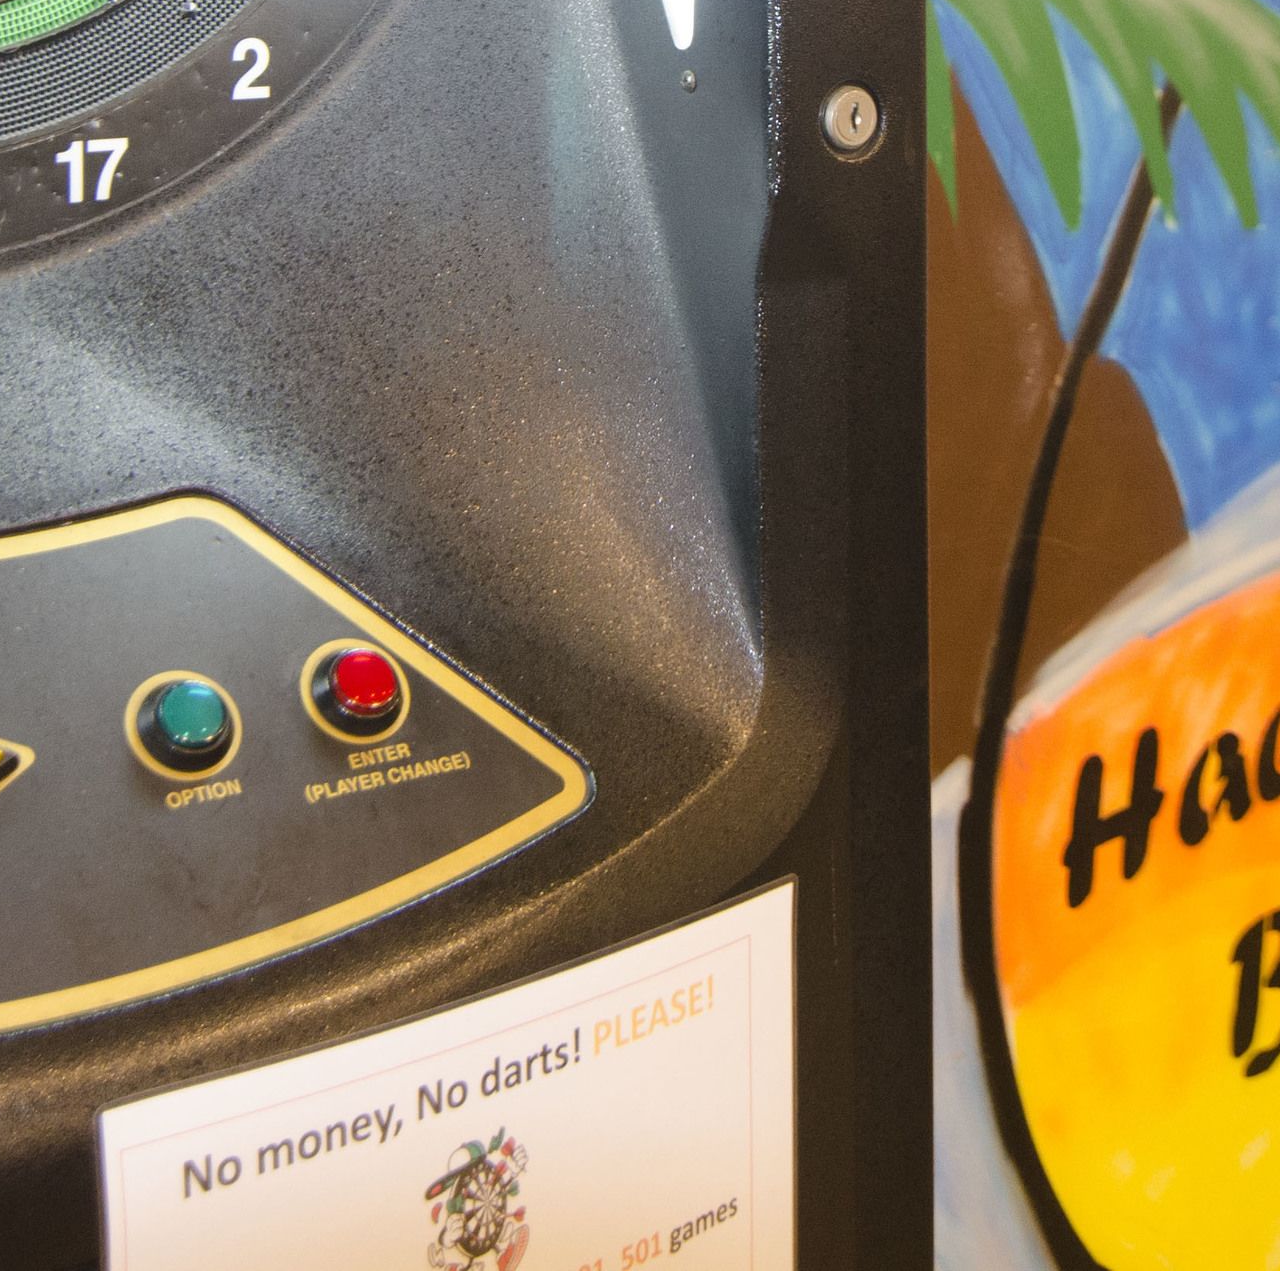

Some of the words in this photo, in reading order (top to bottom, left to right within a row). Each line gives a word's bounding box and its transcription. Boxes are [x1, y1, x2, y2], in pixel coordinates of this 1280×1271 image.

[231, 37, 272, 101] 2
[55, 137, 129, 205] 17
[304, 772, 385, 804] (PLAYER
[386, 751, 471, 785] CHANGE)
[347, 742, 412, 770] ENTER
[165, 779, 242, 809] OPTION
[181, 1152, 243, 1199] No
[257, 1103, 404, 1175] money,
[416, 1078, 468, 1121] No
[480, 1027, 582, 1098] darts!
[592, 973, 715, 1056] PLEASE!
[621, 1231, 663, 1271] 501
[668, 1196, 738, 1254] games
